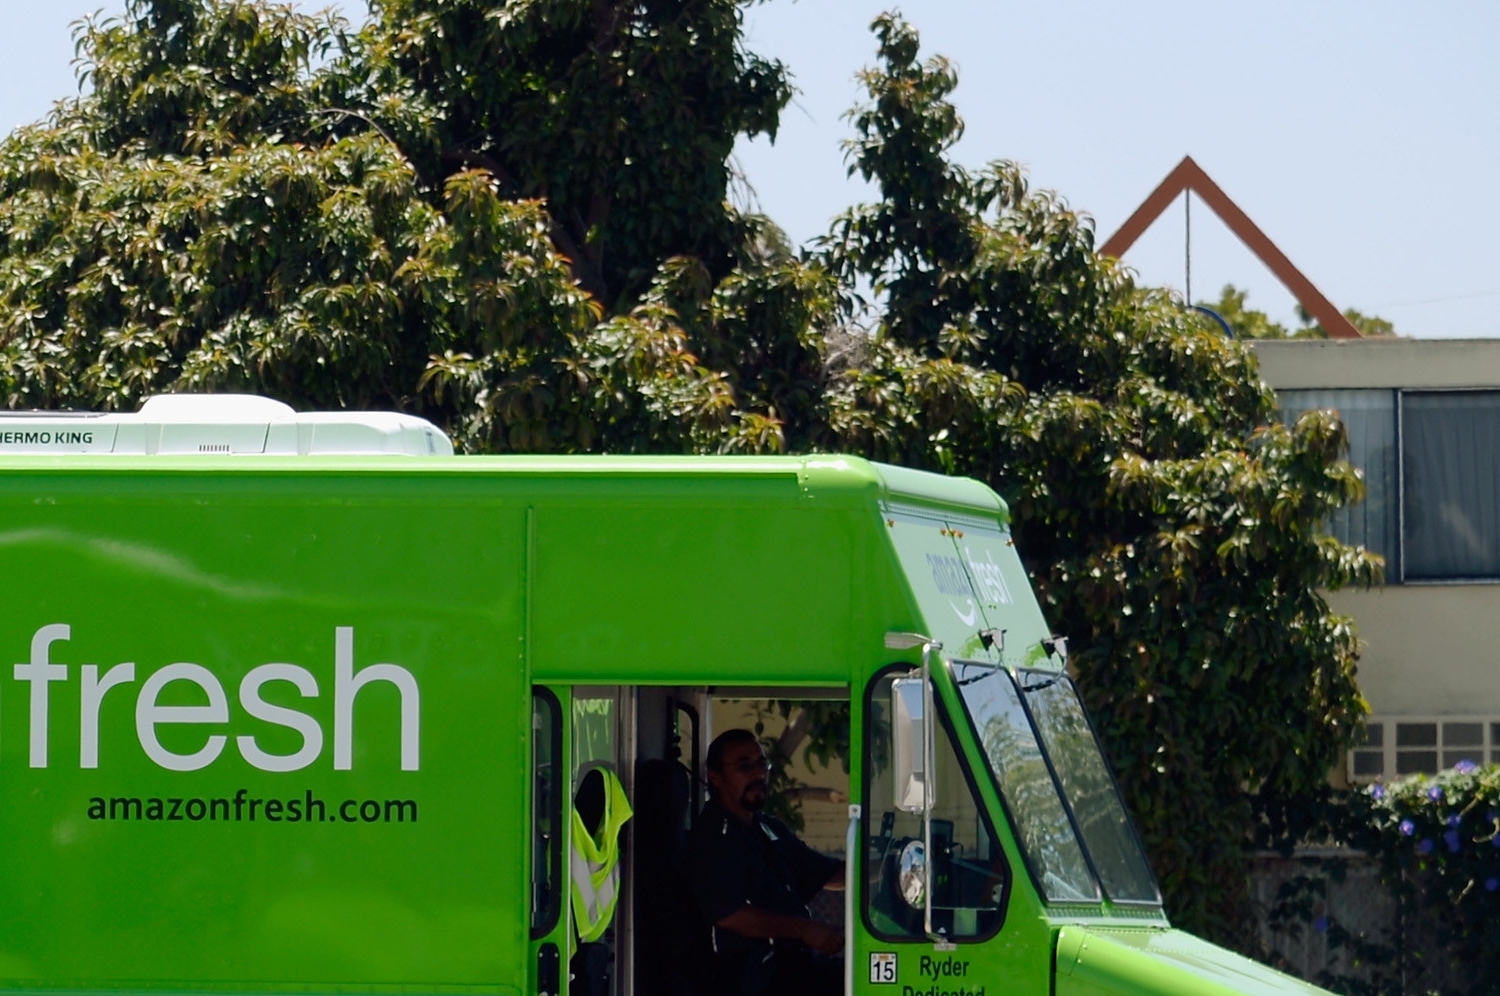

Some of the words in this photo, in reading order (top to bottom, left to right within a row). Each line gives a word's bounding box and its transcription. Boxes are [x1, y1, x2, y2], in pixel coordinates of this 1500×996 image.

[55, 432, 92, 444] KING
[87, 790, 418, 823] amazonfresh.com
[873, 961, 894, 981] 15
[920, 956, 969, 981] Ryder
